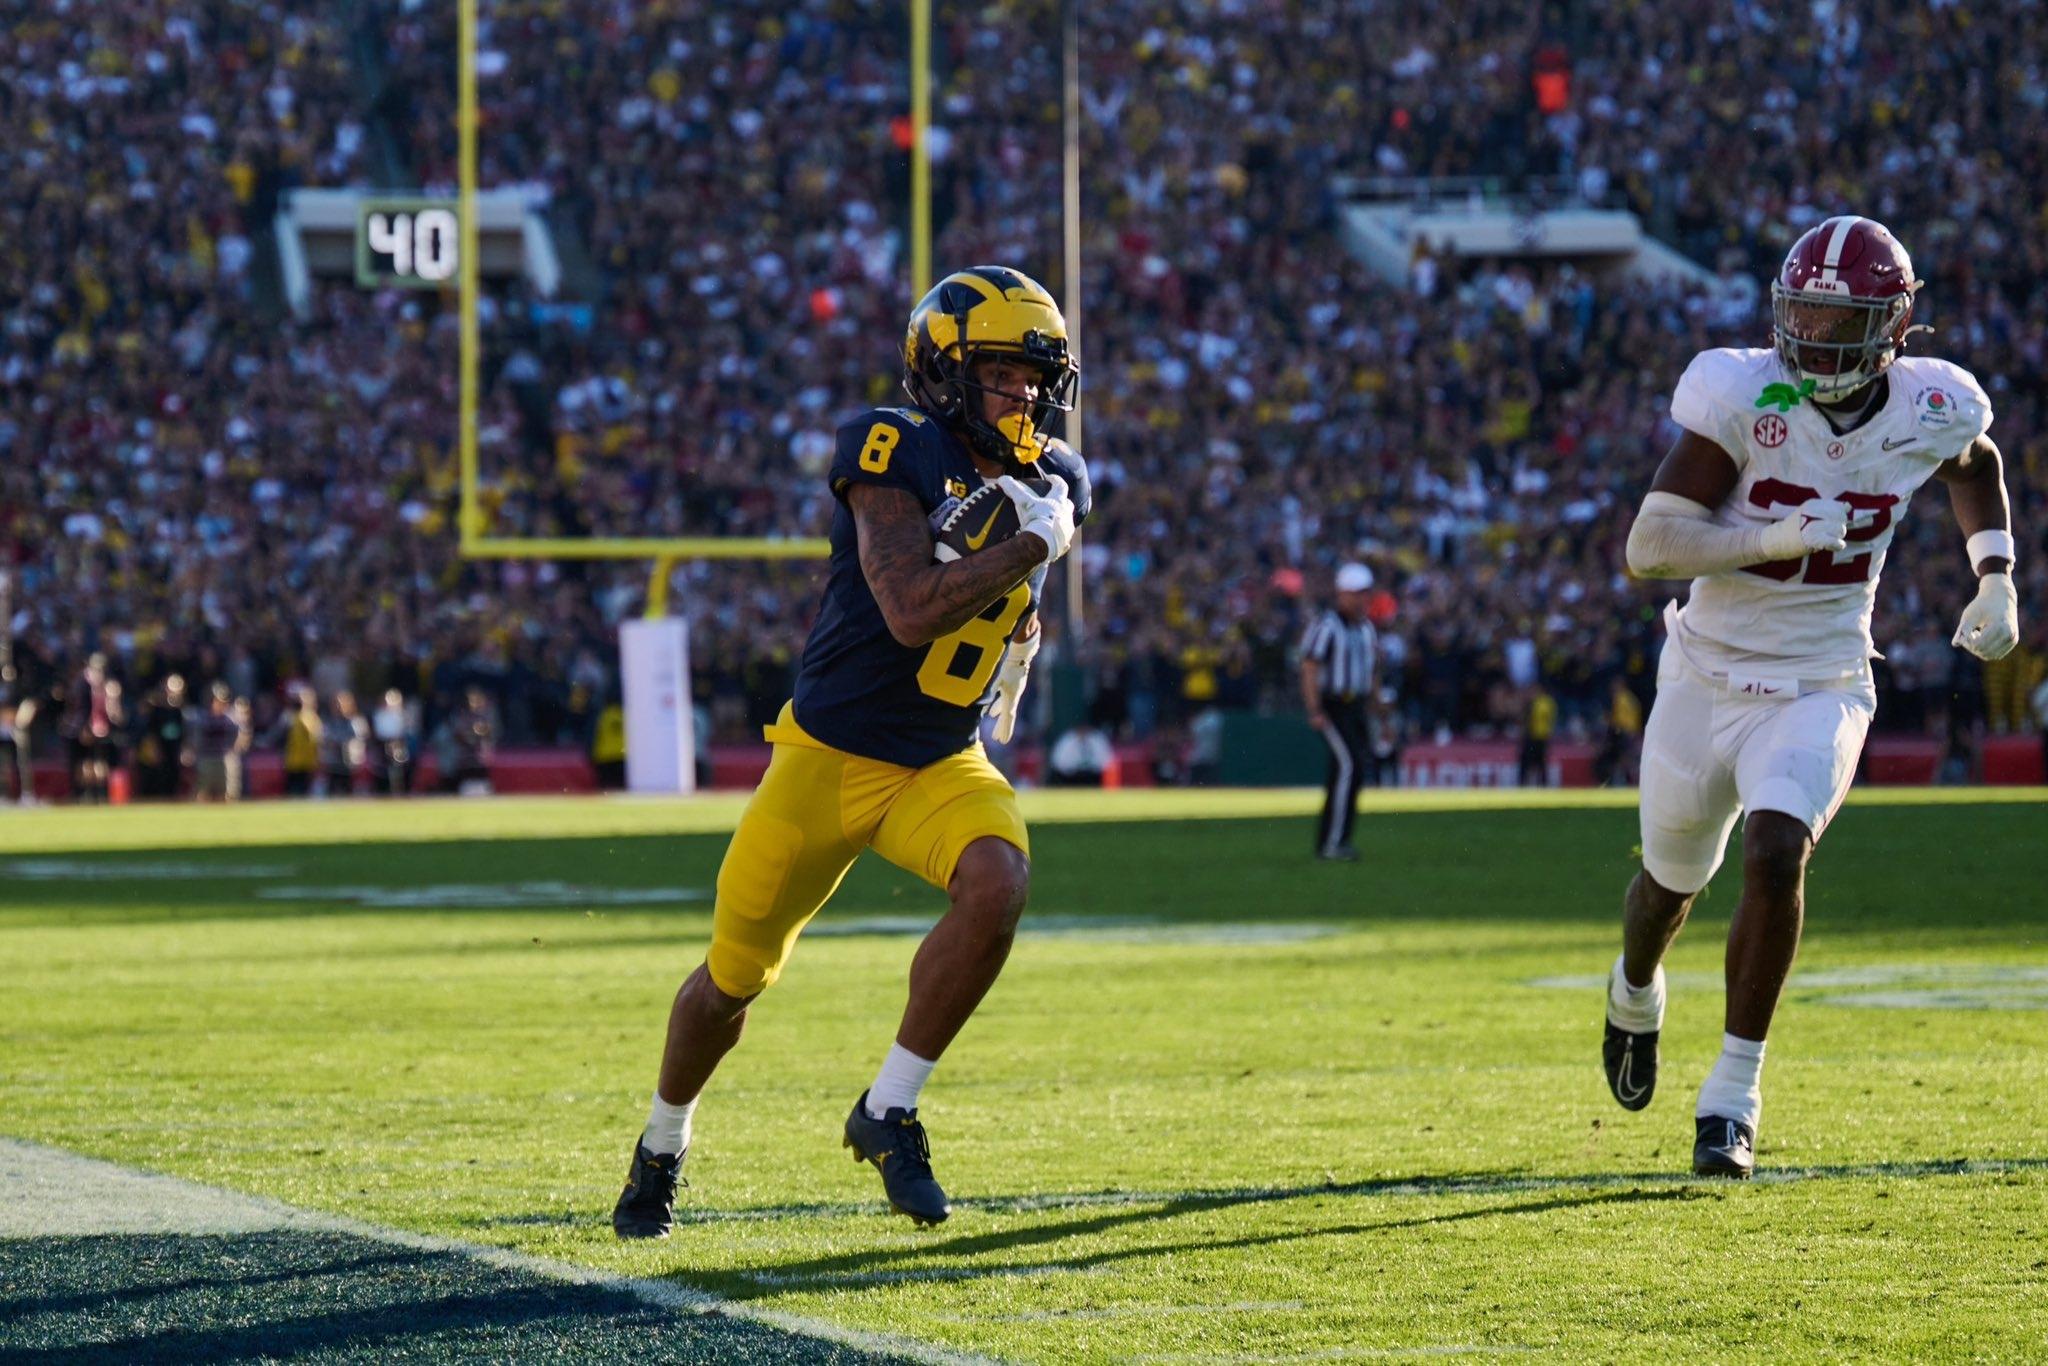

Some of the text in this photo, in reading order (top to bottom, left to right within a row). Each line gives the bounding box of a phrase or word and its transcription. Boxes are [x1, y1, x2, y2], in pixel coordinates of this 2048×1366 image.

[368, 209, 458, 280] 40
[858, 421, 900, 475] 8
[1756, 415, 1785, 447] SEC
[916, 581, 1031, 708] 8
